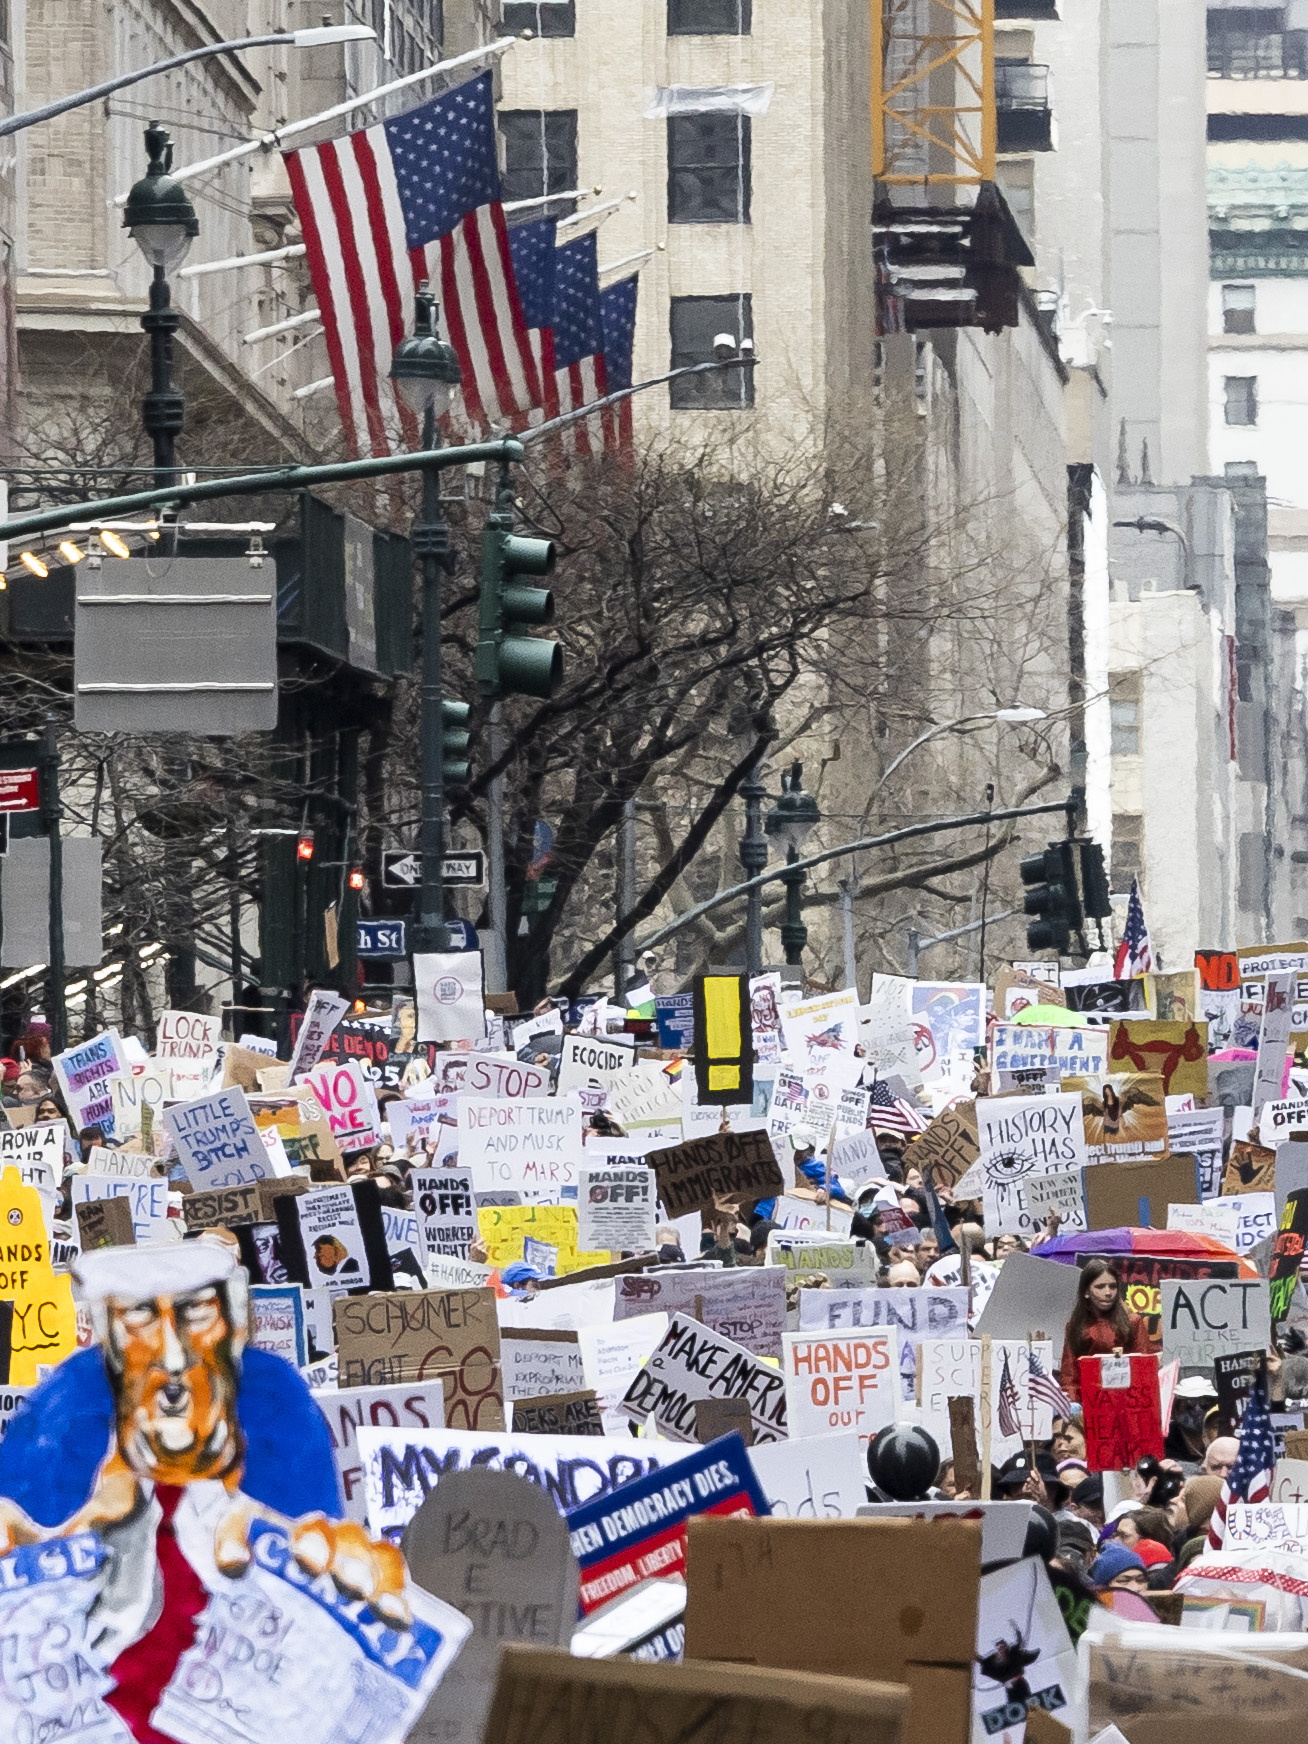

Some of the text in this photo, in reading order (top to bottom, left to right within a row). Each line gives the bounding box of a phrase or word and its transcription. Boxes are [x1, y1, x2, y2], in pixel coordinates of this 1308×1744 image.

[444, 861, 472, 876] WAY
[376, 930, 399, 948] St
[1200, 956, 1239, 990] NO
[1242, 958, 1305, 974] PROTECT
[162, 1016, 213, 1042] LOCK
[1068, 1031, 1083, 1051] A
[69, 1042, 107, 1069] TRANS
[160, 1040, 213, 1060] TRUMP
[75, 1057, 120, 1088] RIGHTS
[471, 1062, 542, 1098] STOP
[88, 1080, 110, 1100] ARE
[118, 1077, 163, 1107] NO
[174, 1096, 235, 1132] LITTLE
[774, 1096, 801, 1112] DATA
[468, 1106, 575, 1129] DEPORT TRUMP
[987, 1106, 1076, 1145] HISTORY
[44, 1129, 56, 1145] A
[485, 1135, 564, 1152] AND MUSK
[906, 1113, 961, 1168] HANDS
[1031, 1138, 1075, 1159] HAS
[93, 1153, 154, 1177] HANDS
[193, 1141, 250, 1172] BITCH
[649, 1130, 768, 1175] HANDS OFF
[833, 1140, 876, 1167] HANDS
[417, 1178, 469, 1191] HANDS
[490, 1161, 575, 1183] TO MARS
[588, 1170, 648, 1184] HANDS
[661, 1160, 782, 1209] IMMIGRANTS
[183, 1187, 256, 1221] RESIST
[419, 1190, 472, 1216] OFF!
[589, 1184, 648, 1204] OFF!
[425, 1226, 474, 1240] WORKER
[776, 1246, 855, 1271] HANDS
[345, 1291, 485, 1336] SCHUMER
[827, 1298, 959, 1330] FUND
[1170, 1282, 1261, 1330] ACT
[1192, 1328, 1239, 1342] LIKE
[653, 1357, 665, 1371] a
[657, 1322, 731, 1380] MAKE
[793, 1341, 890, 1376] HANDS
[346, 1354, 409, 1387] FIGHT
[810, 1374, 878, 1406] OFF
[828, 1410, 865, 1427] our
[603, 1459, 739, 1544] DEMOCRACY DIES,
[1227, 1506, 1295, 1544] USA
[580, 1538, 684, 1604] FREEDOM, LIBERTY
